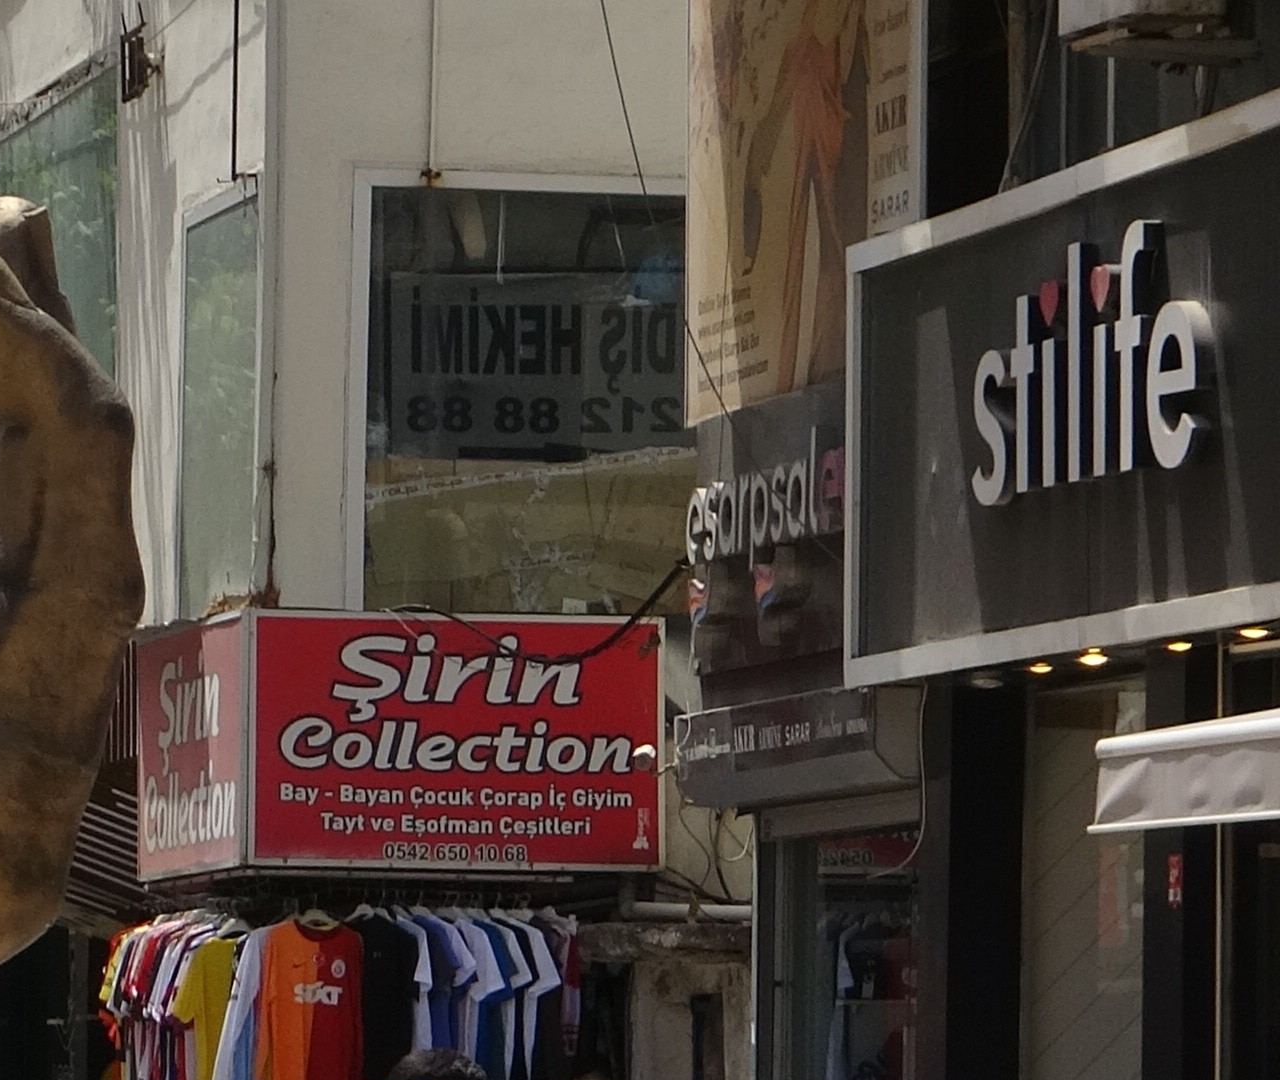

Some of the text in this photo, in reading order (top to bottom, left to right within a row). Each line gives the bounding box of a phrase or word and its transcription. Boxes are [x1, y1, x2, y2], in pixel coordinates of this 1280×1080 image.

[872, 189, 909, 225] SARAR
[971, 218, 1197, 507] stilife
[332, 634, 582, 722] Şirin
[158, 648, 220, 778] Şirin
[784, 721, 811, 746] SARAR
[279, 716, 632, 774] Collection
[144, 759, 236, 854] Collection
[279, 782, 319, 806] Bay
[340, 784, 404, 807] Bayan
[410, 786, 474, 809] Çocuk
[480, 787, 543, 811] Çorap
[549, 783, 567, 811] İç
[572, 788, 632, 811] Giyim
[320, 812, 591, 839] Tayt ve Eşofman Çeşitleri
[384, 842, 528, 863] 0542 650 10 68
